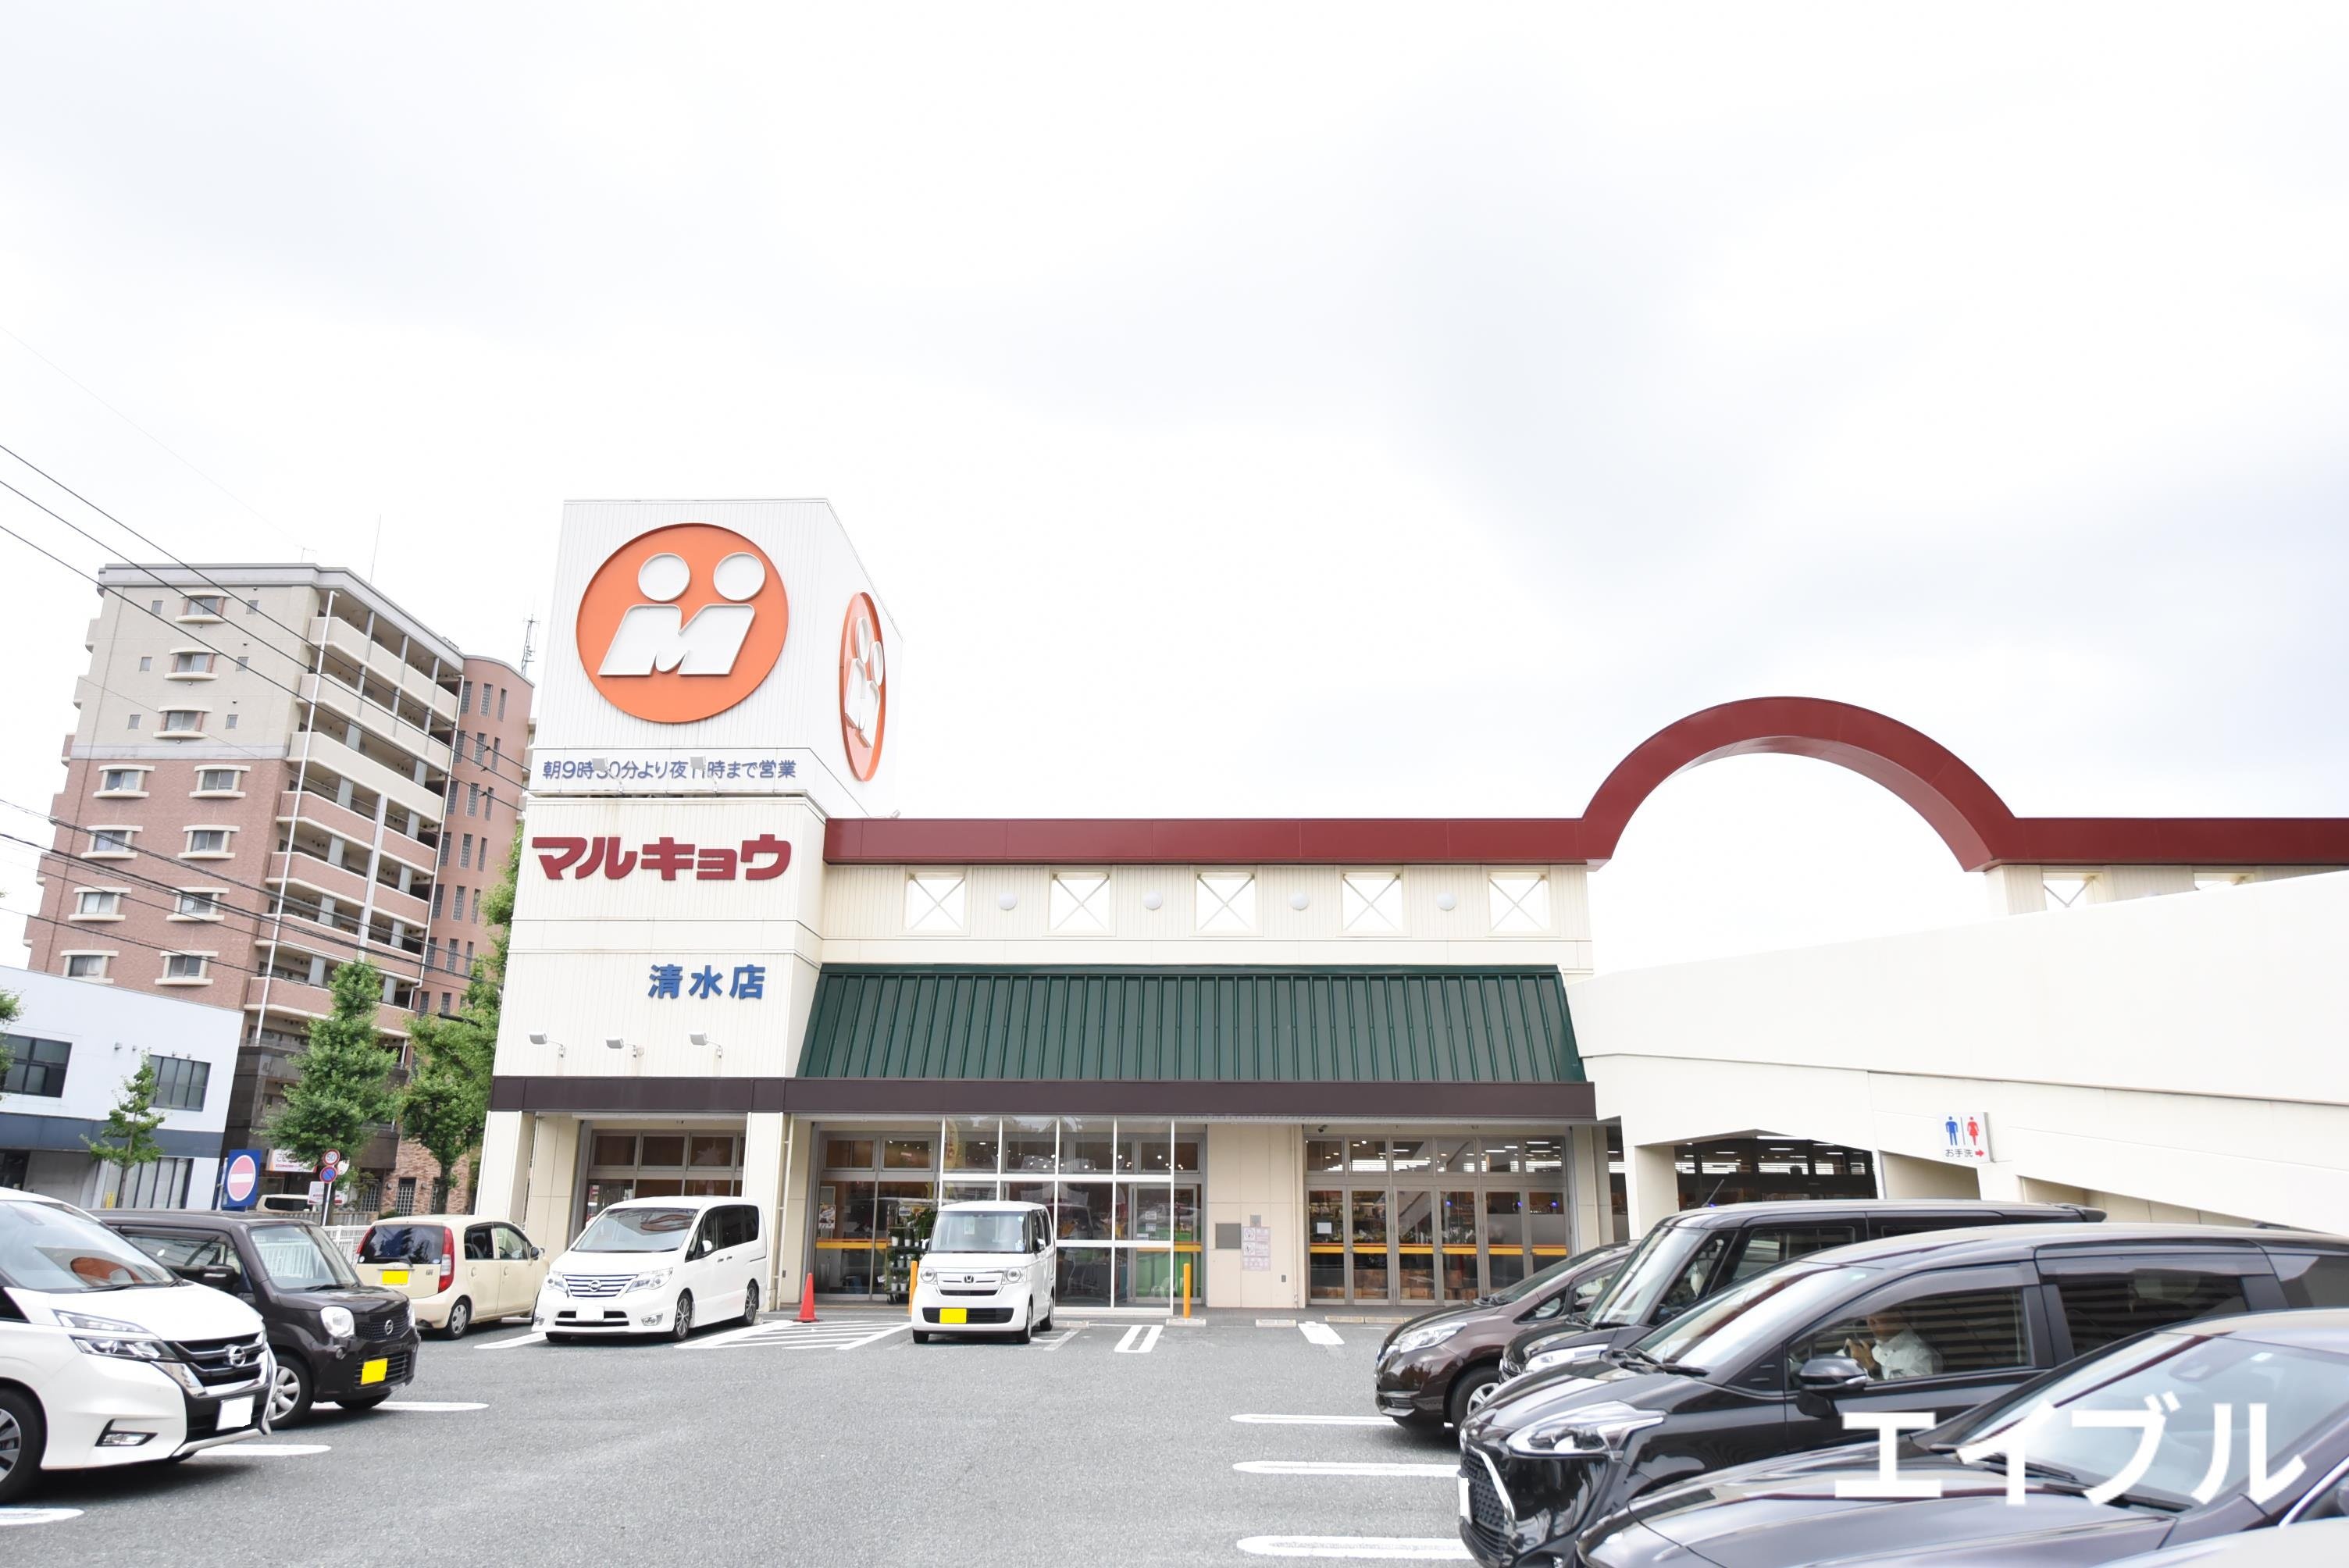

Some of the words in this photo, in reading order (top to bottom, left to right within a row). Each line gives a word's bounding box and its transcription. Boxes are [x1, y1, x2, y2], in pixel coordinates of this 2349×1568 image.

[531, 832, 792, 881] マルキョウ
[647, 964, 766, 1000] 清水店
[1945, 1148, 1973, 1157] お手洗
